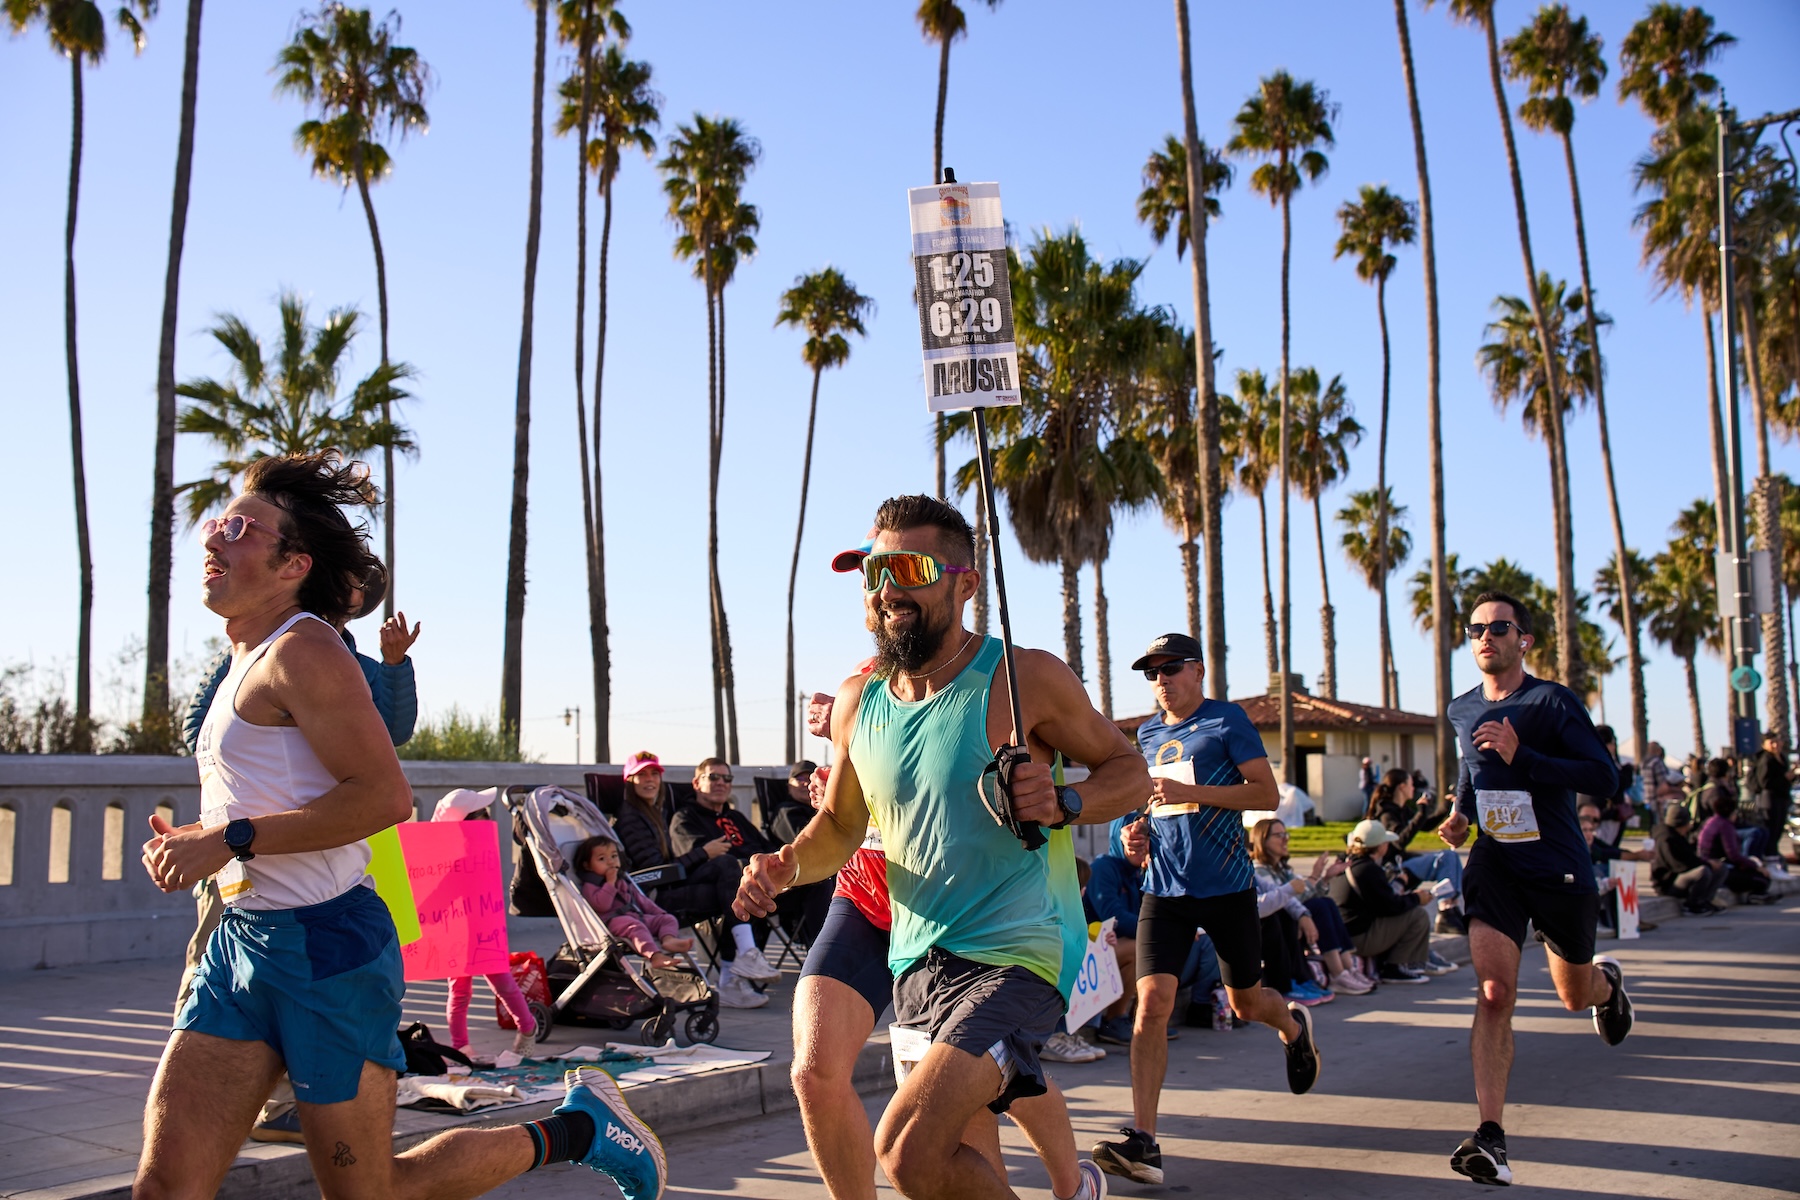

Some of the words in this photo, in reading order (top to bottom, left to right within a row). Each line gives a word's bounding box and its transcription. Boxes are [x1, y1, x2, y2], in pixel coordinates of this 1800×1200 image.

[928, 252, 995, 291] 1:25
[929, 297, 1003, 337] 6:29
[950, 335, 969, 344] MINUTE
[1482, 804, 1525, 824] 7192
[432, 896, 471, 934] uphill
[1076, 952, 1099, 995] GO
[605, 1121, 645, 1156] HOKA
